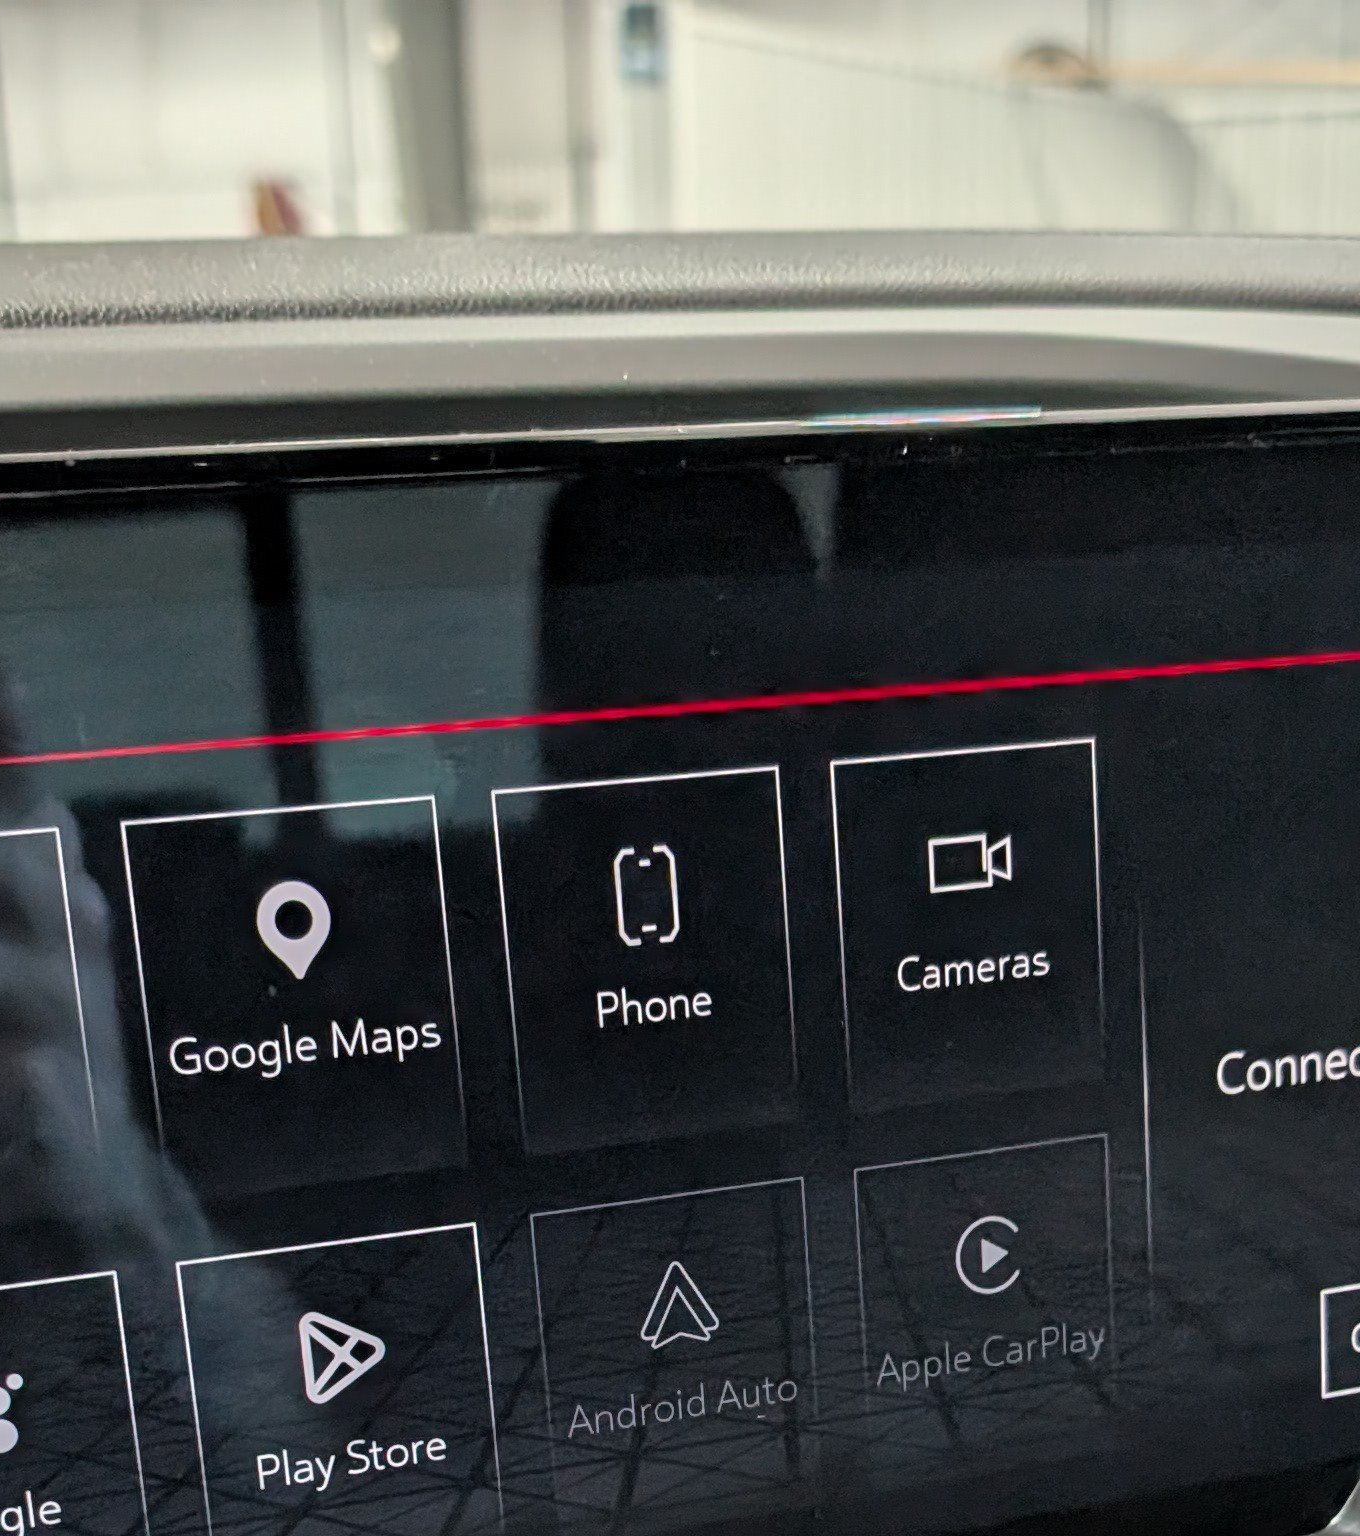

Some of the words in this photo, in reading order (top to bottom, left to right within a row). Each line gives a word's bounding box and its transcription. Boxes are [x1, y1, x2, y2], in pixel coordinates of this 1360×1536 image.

[897, 951, 1050, 991] Cameras
[596, 987, 713, 1028] Phone
[169, 1024, 317, 1078] Google
[331, 1018, 441, 1062] Maps
[877, 1342, 971, 1392] Apple
[983, 1323, 1106, 1368] CarPlay
[568, 1384, 706, 1438] Android
[717, 1376, 798, 1413] Auto
[256, 1447, 335, 1491] Play
[347, 1433, 447, 1476] Store
